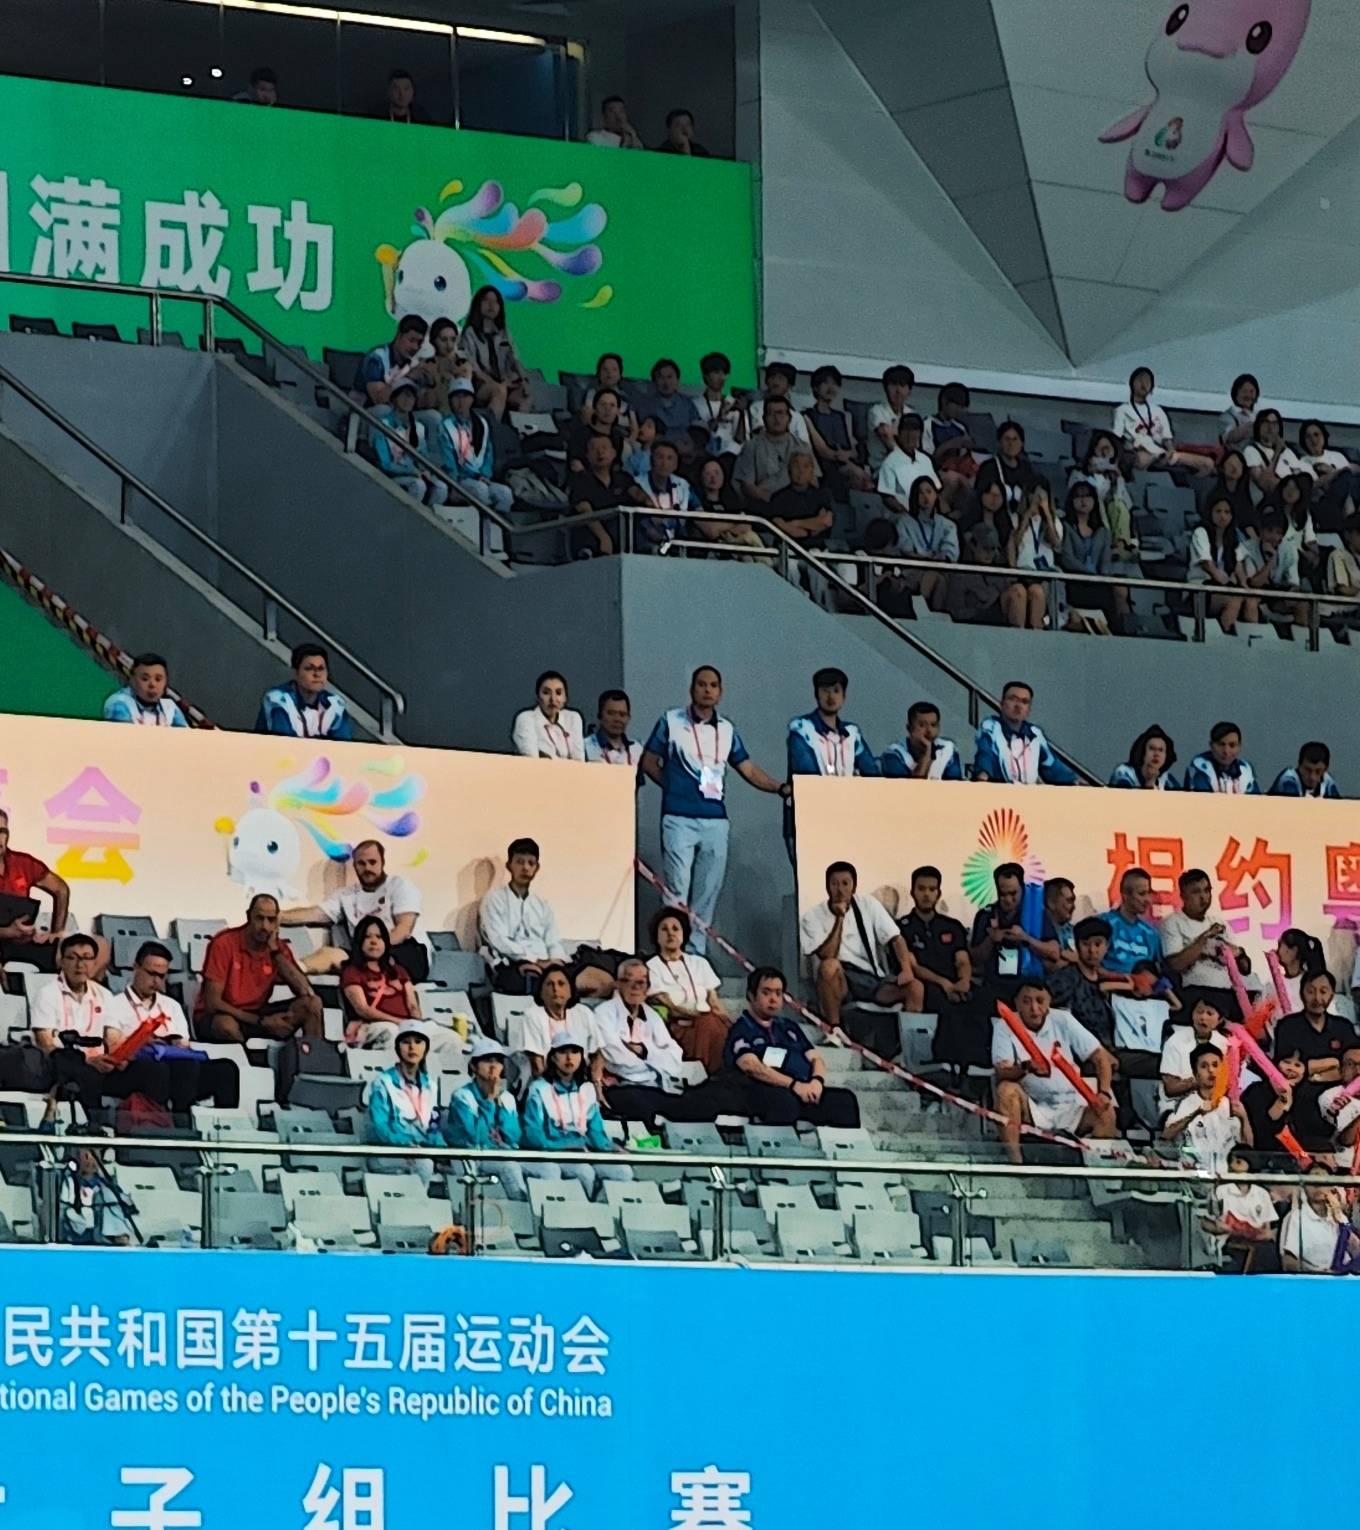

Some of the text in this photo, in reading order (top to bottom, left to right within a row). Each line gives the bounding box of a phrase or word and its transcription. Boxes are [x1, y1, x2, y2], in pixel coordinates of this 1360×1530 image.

[84, 1382, 179, 1412] Games
[186, 1381, 213, 1412] of
[220, 1382, 263, 1412] the
[271, 1384, 381, 1420] People's
[389, 1385, 503, 1421] Republic
[507, 1386, 534, 1416] of
[541, 1387, 613, 1417] China
